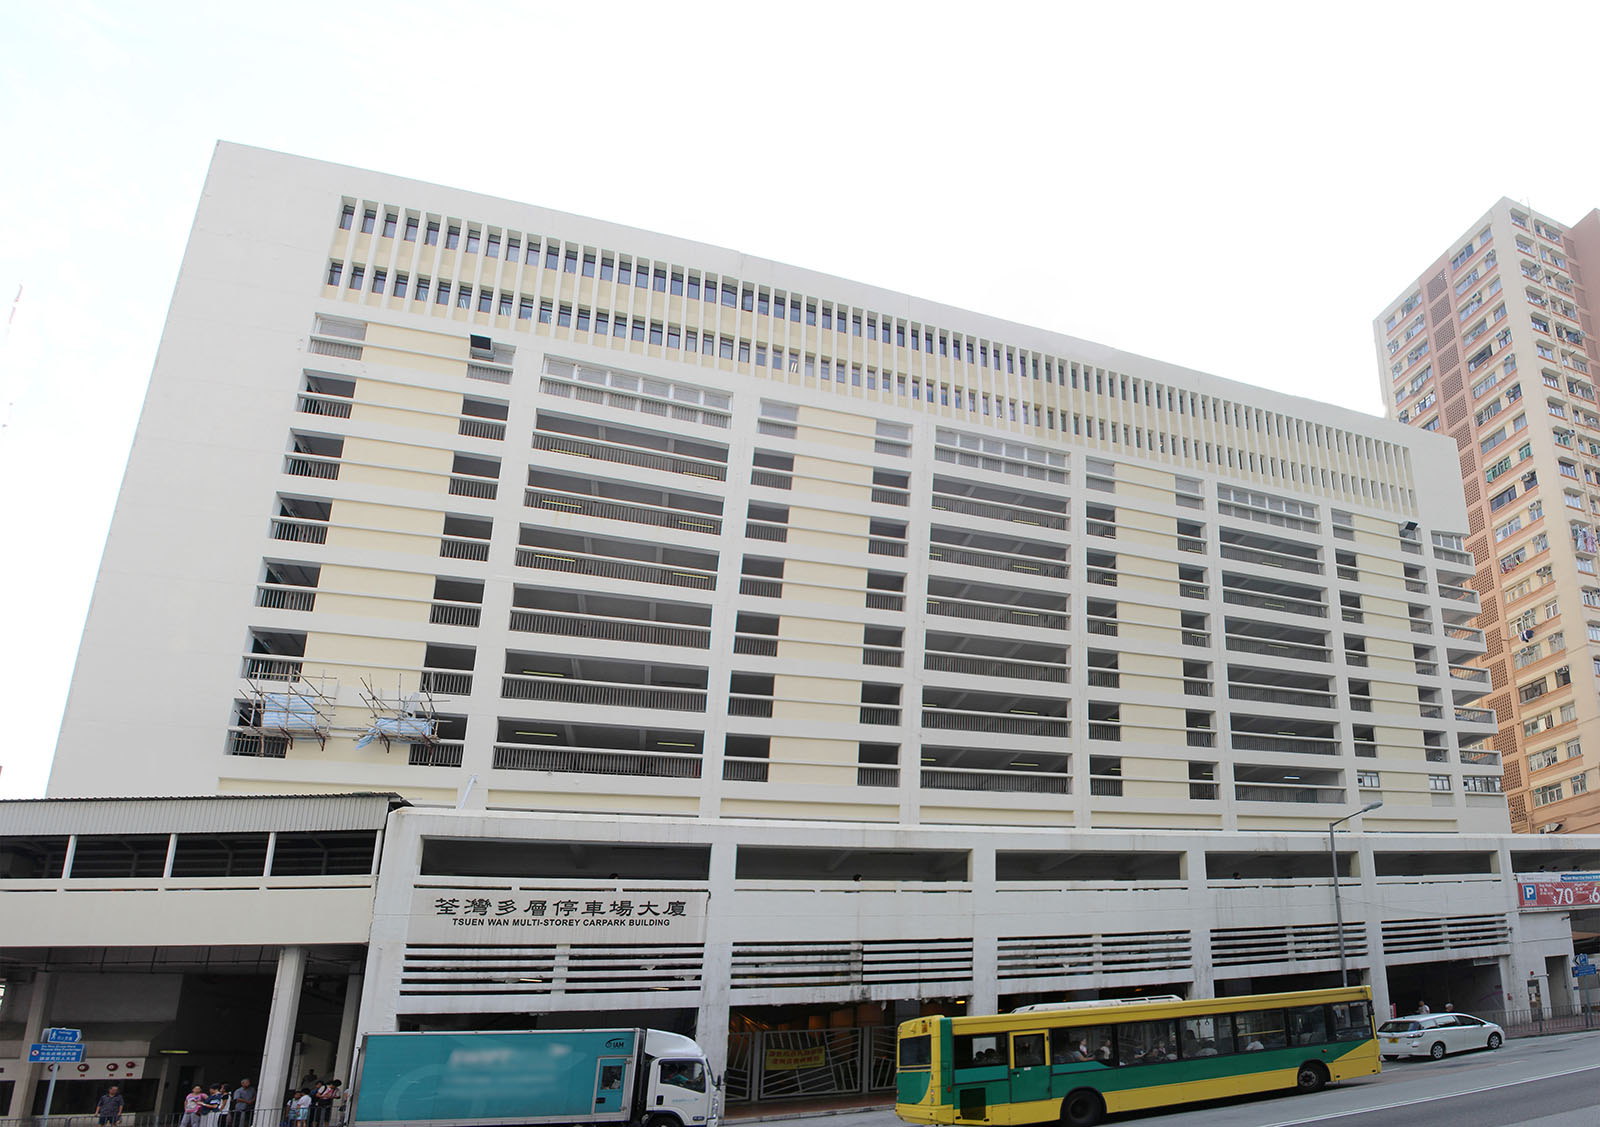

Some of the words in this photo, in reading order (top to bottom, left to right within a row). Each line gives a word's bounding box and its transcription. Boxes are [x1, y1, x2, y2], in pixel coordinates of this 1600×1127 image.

[1526, 888, 1534, 898] P
[1552, 888, 1574, 905] $70
[434, 898, 687, 917] 荃灣多層停車場大廈
[452, 918, 484, 926] TSUEN
[487, 918, 509, 926] WAN
[512, 918, 580, 926] MULTI-STOREY
[583, 918, 626, 926] CARPARK
[629, 918, 670, 926] BUILDING
